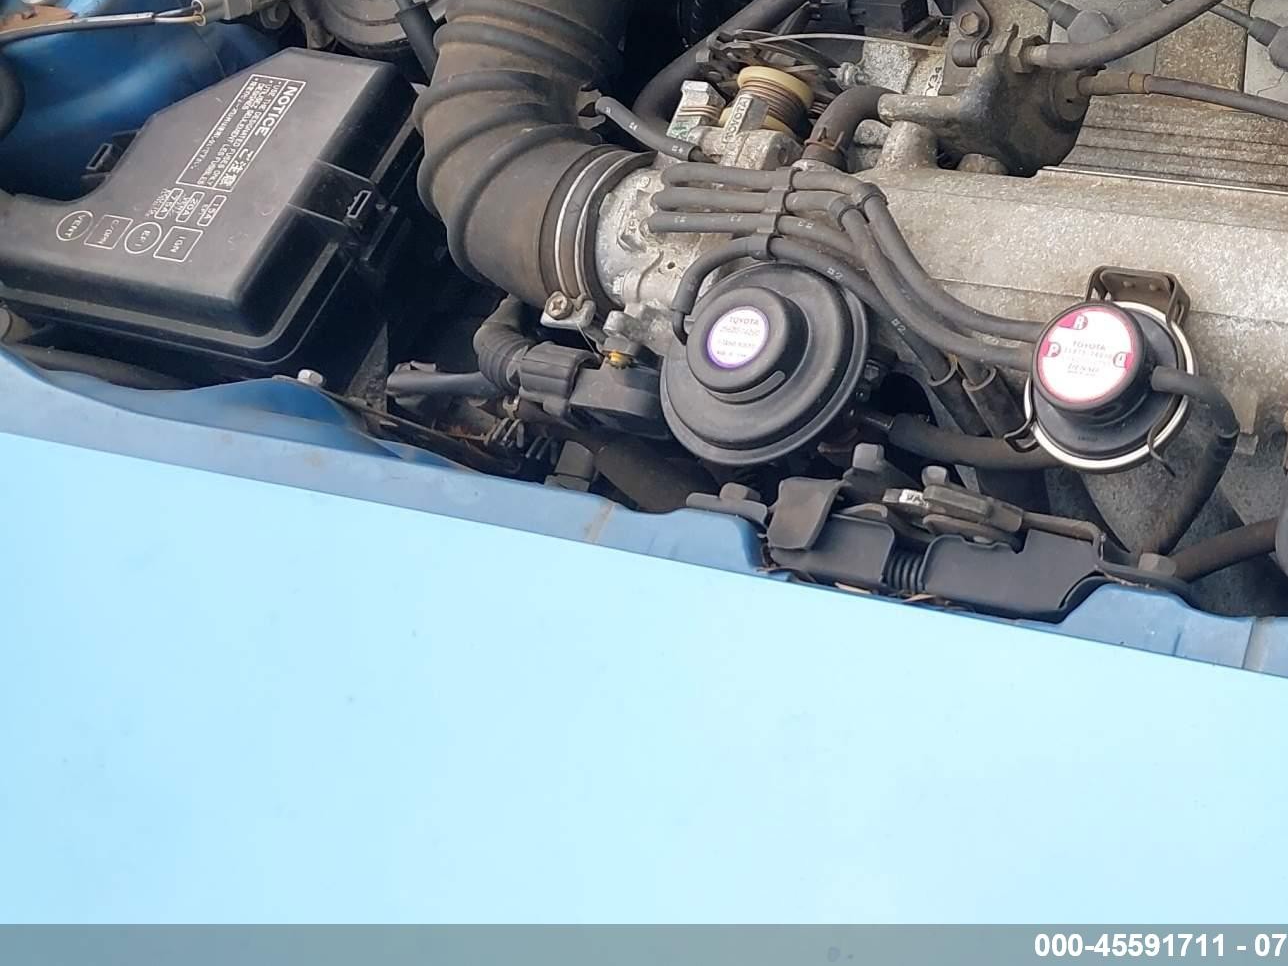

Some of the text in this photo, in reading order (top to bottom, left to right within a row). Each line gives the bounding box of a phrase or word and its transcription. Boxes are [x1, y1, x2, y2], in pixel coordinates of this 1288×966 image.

[253, 85, 298, 137] NOTICE
[724, 98, 748, 140] TOYOTA
[217, 148, 236, 168] FUSES
[183, 198, 200, 216] 20A
[203, 203, 221, 219] 15A
[65, 214, 86, 238] VENT
[170, 236, 187, 253] IGN
[729, 316, 760, 325] TOYOTA
[1073, 341, 1106, 351] TOYOTA
